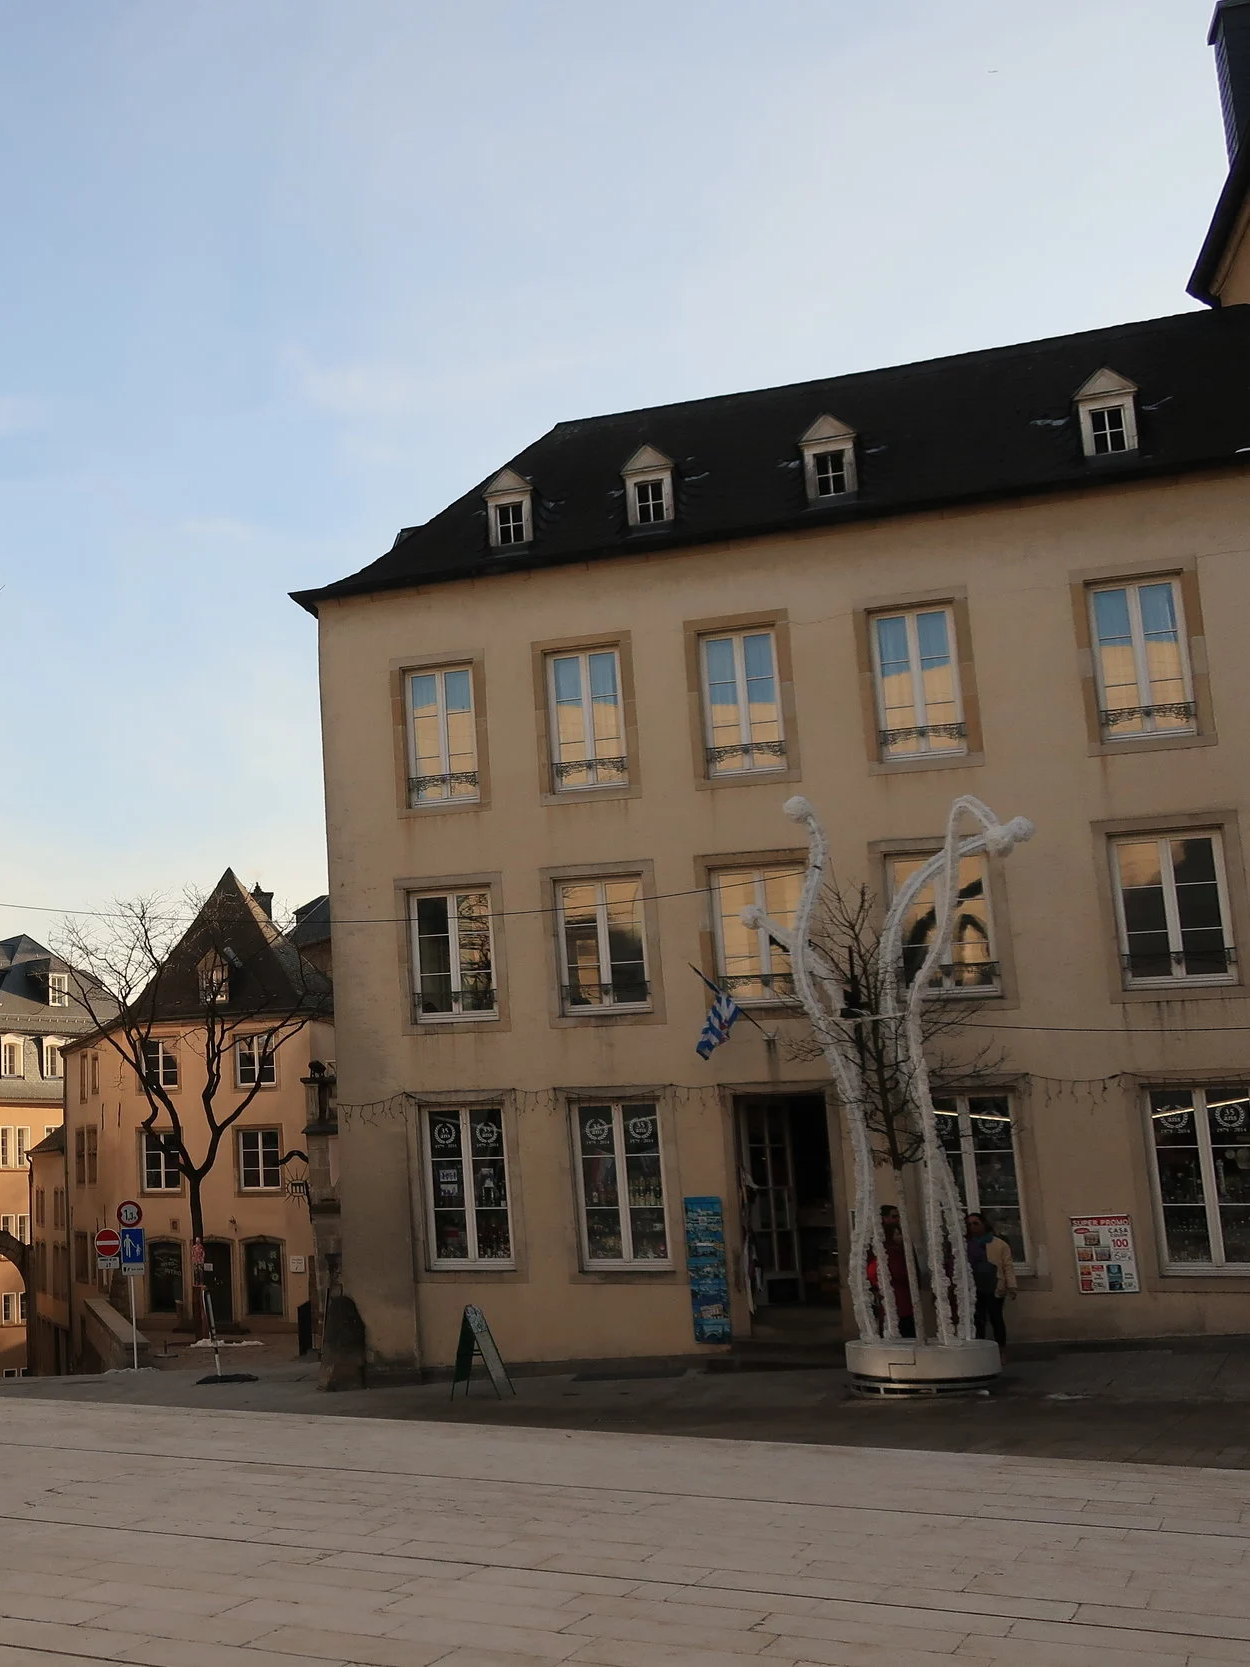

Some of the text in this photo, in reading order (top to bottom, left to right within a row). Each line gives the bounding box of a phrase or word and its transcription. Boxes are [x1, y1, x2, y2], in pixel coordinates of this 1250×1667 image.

[1072, 1218, 1129, 1227] SUPER PROMO
[1112, 1238, 1130, 1248] 100
